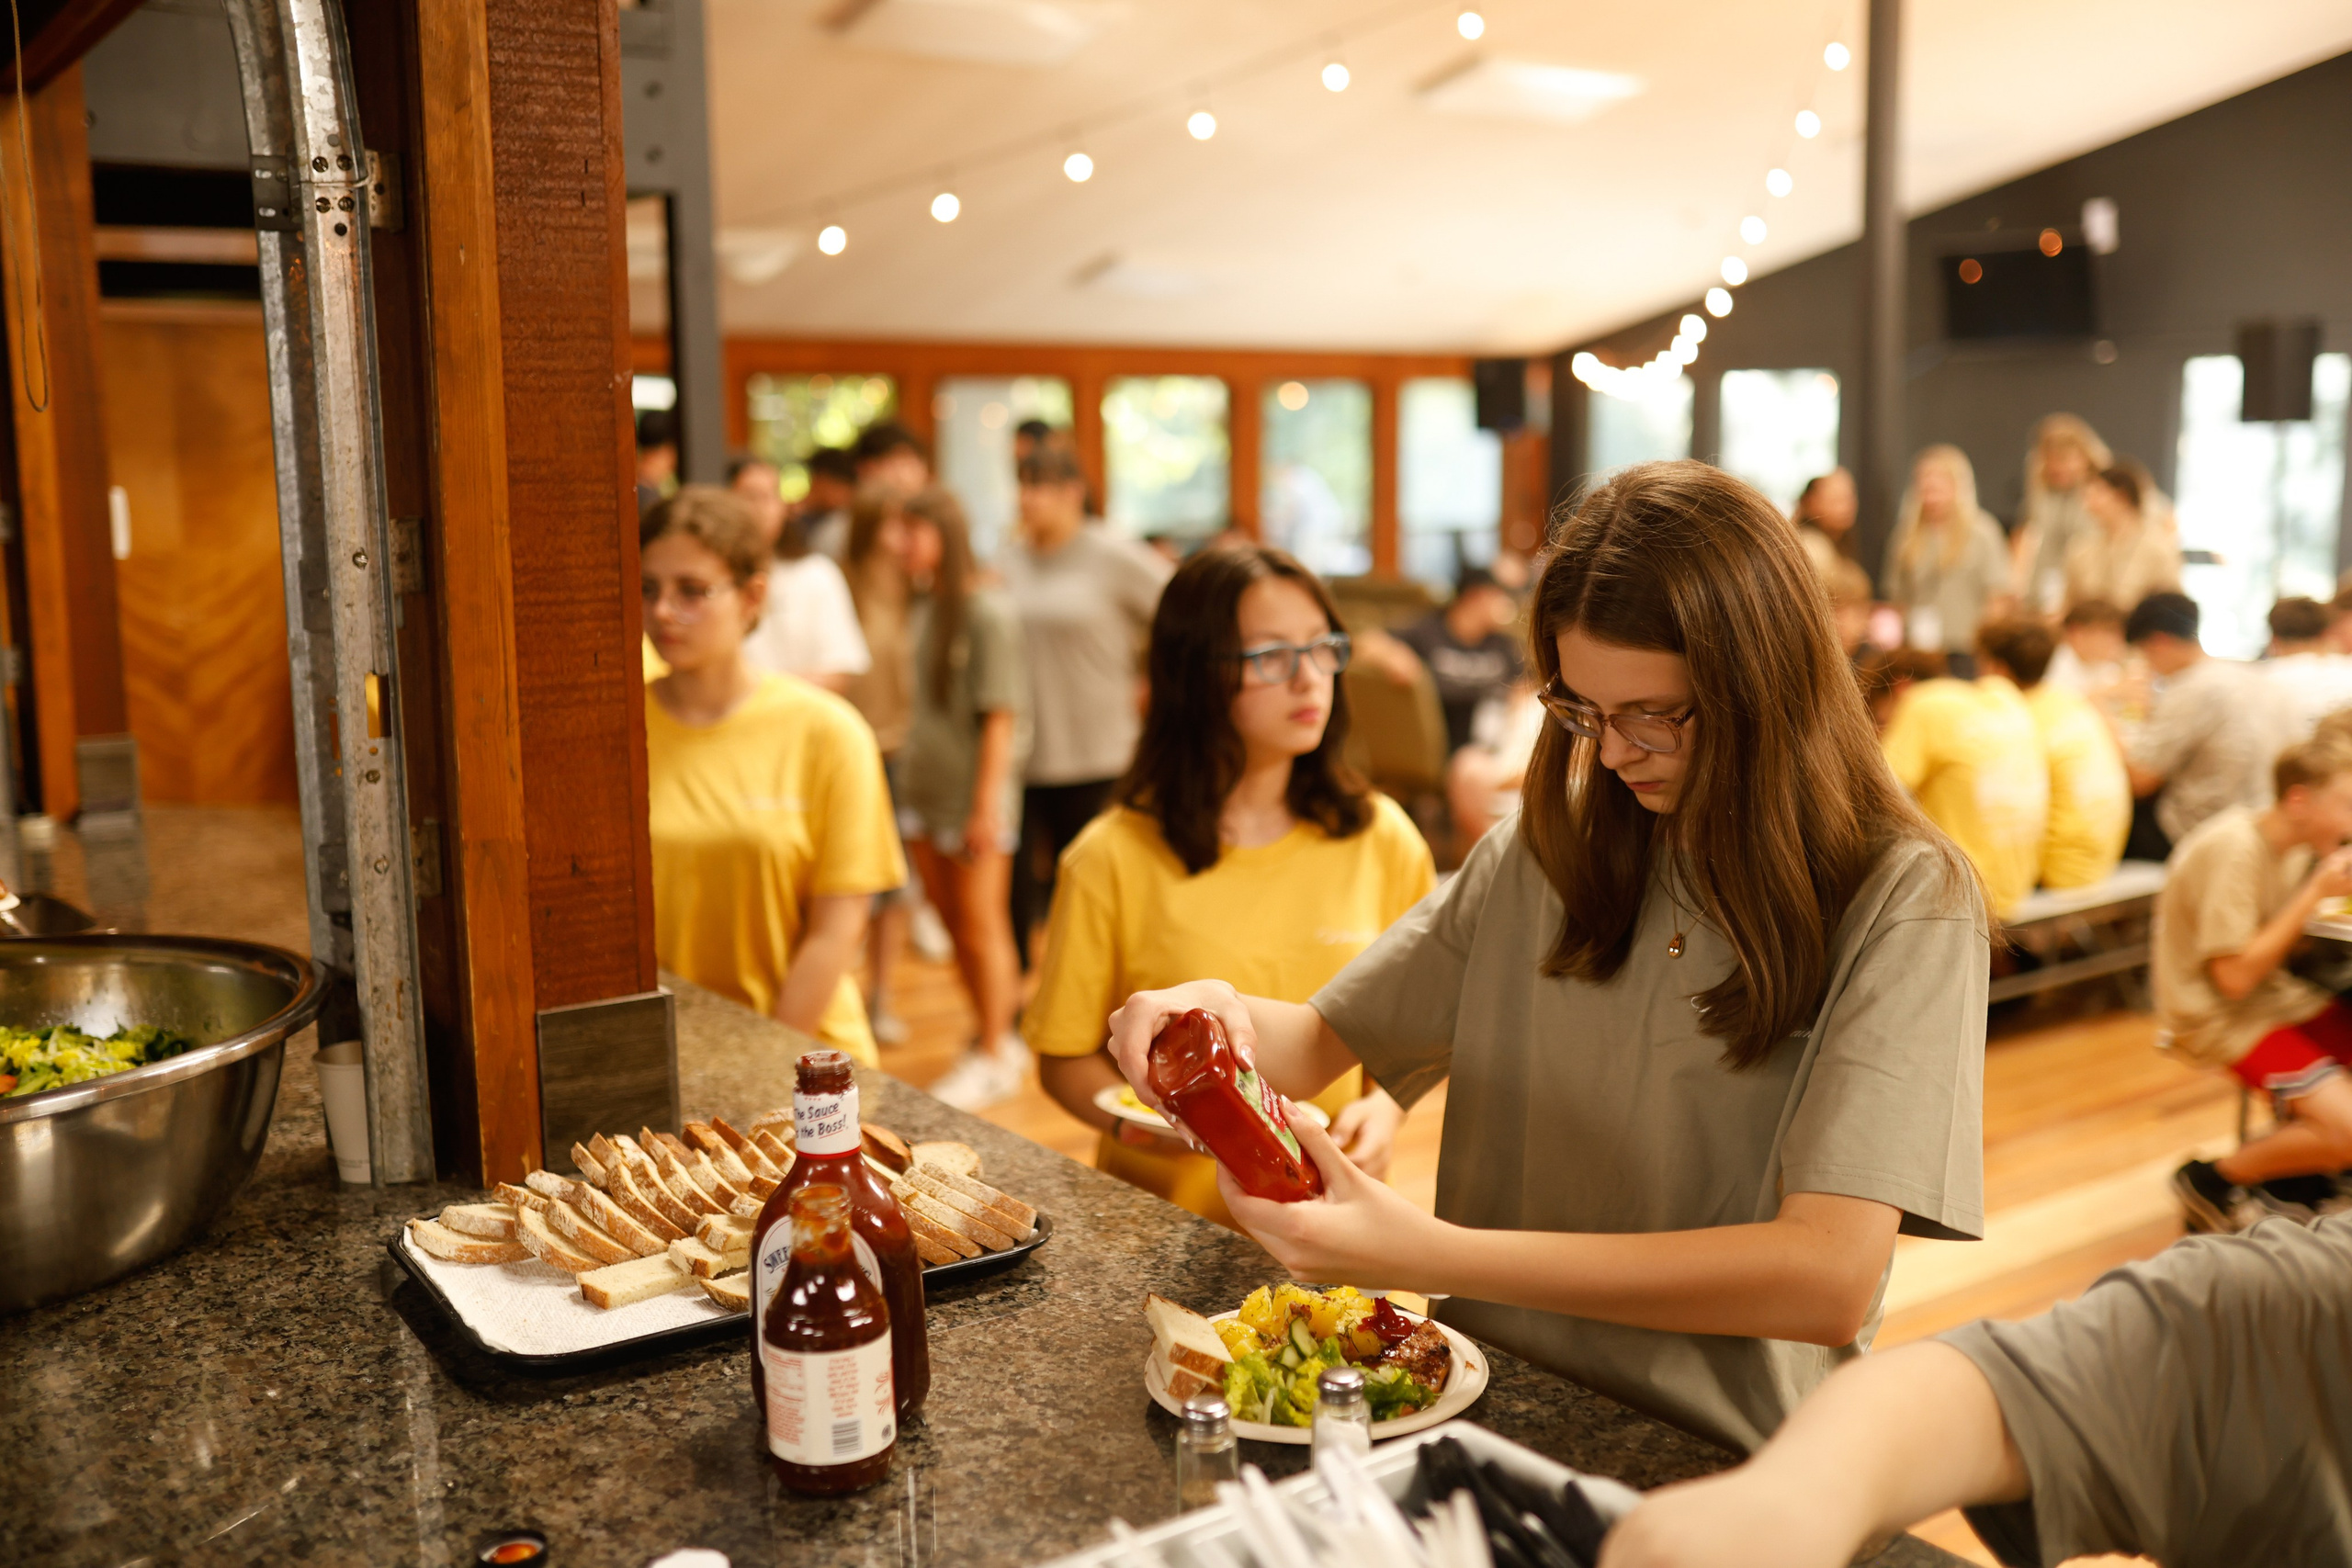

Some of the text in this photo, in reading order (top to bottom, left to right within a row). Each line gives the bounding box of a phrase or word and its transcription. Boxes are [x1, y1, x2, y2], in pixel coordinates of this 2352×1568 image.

[808, 1102, 839, 1120] Sauce
[800, 1125, 814, 1139] the
[818, 1113, 846, 1136] Boss!
[763, 1246, 791, 1274] SWEE
